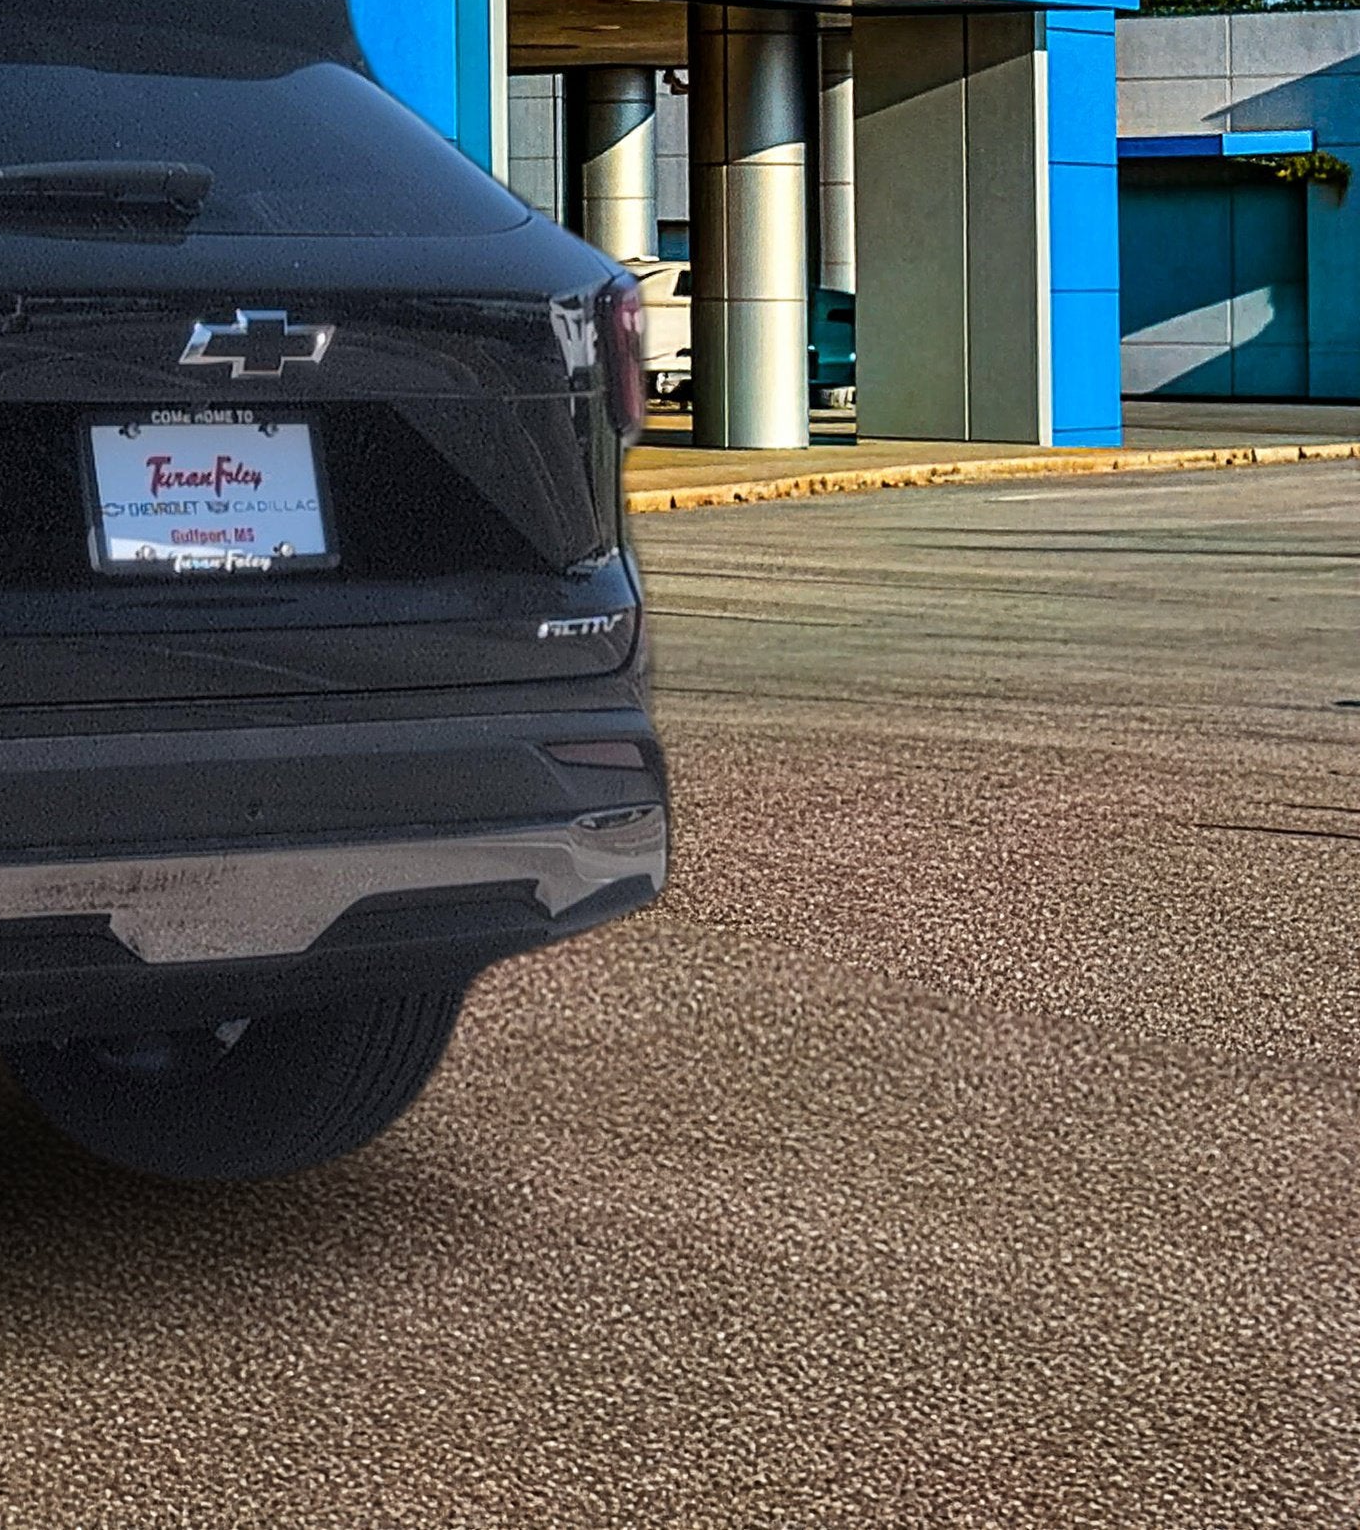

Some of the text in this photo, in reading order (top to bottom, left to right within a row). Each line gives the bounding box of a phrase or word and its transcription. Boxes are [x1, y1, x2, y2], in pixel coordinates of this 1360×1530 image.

[235, 409, 254, 424] TO
[214, 455, 263, 499] Foley
[128, 499, 320, 516] CHEVROLET CADILLAC
[234, 527, 255, 543] MS
[536, 613, 624, 639] ACTIV
